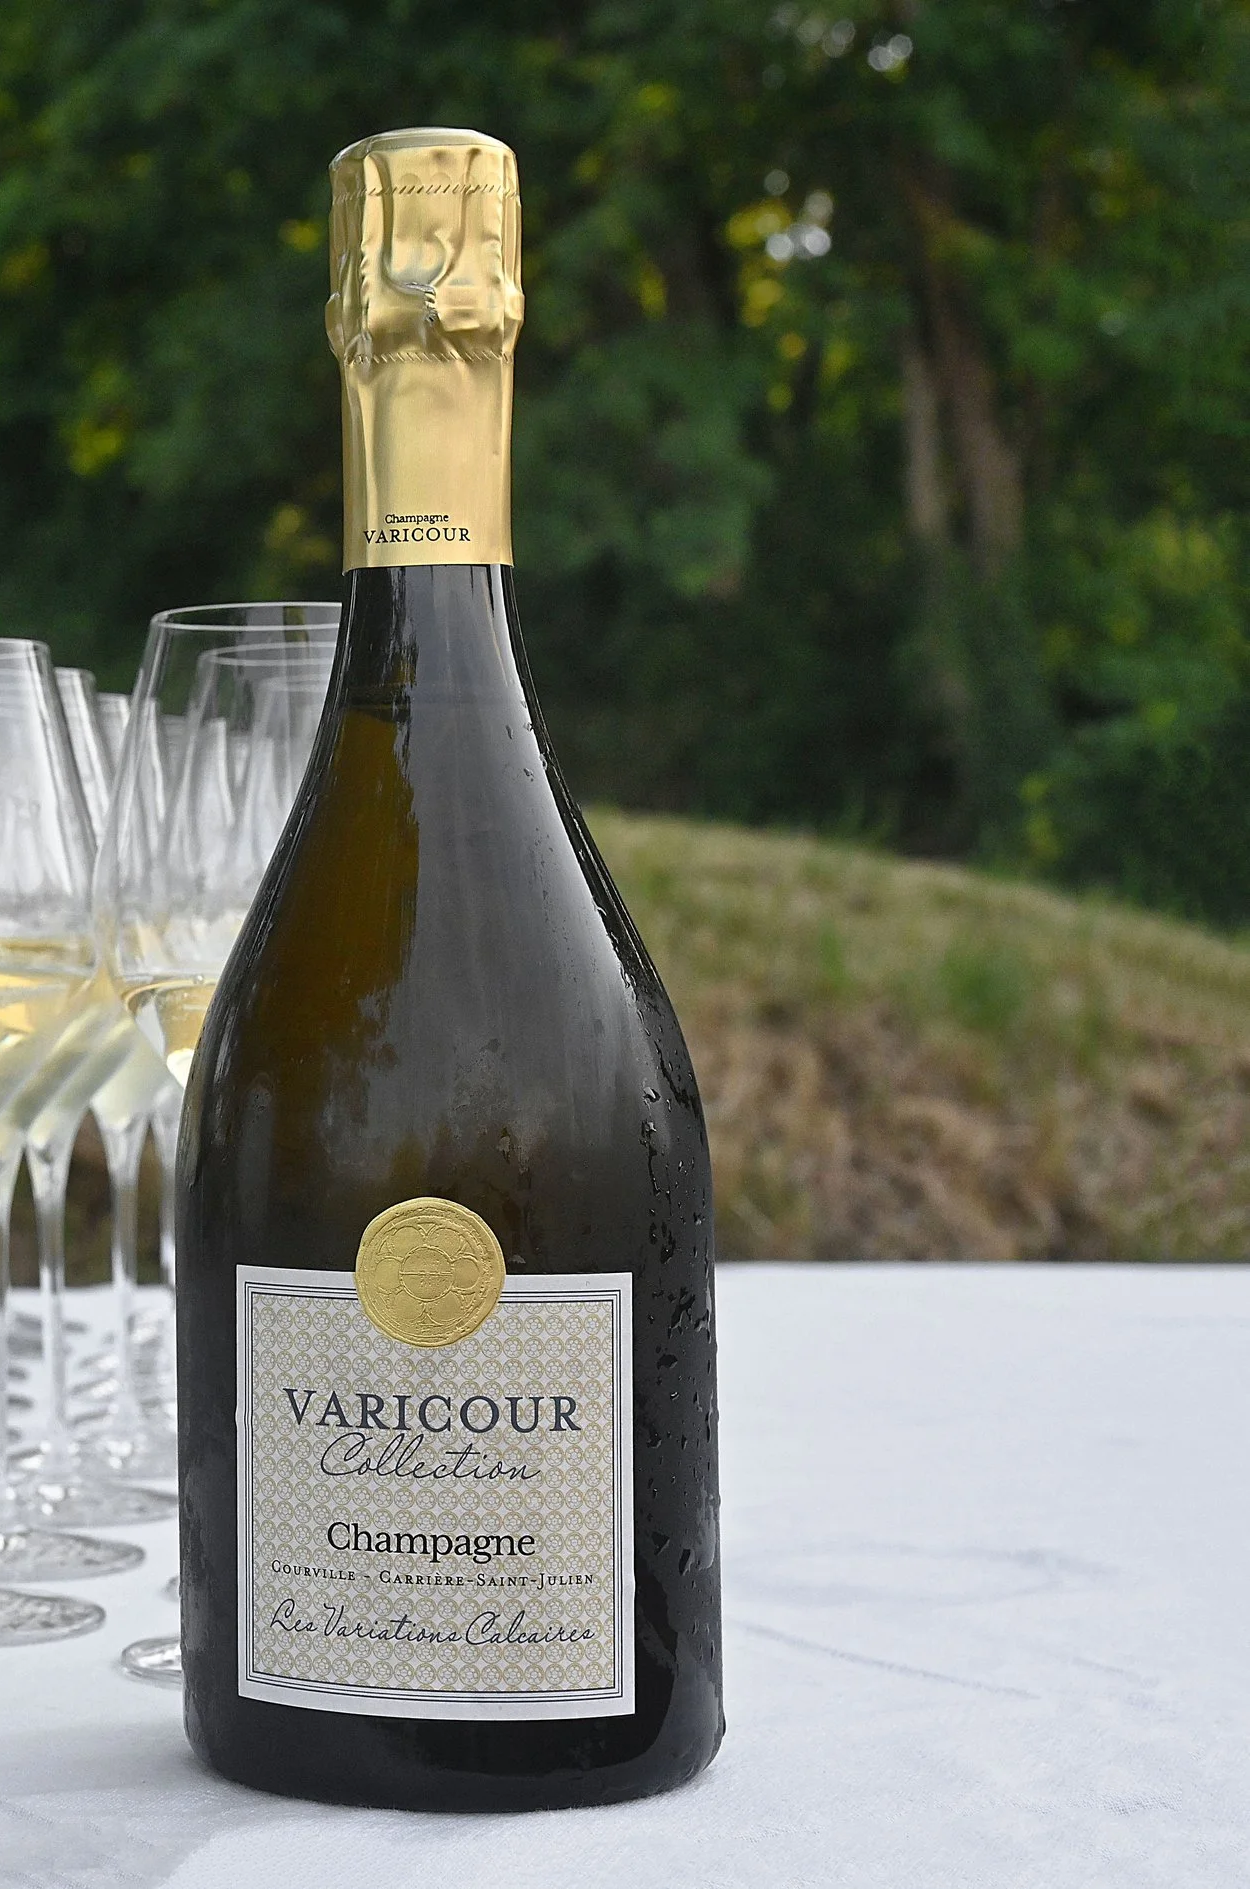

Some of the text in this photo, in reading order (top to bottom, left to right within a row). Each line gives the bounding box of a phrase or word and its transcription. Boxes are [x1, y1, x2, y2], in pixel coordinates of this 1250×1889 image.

[363, 527, 471, 544] VARICOUR
[384, 514, 449, 525] Champagne
[282, 1387, 582, 1434] VARICOUR
[320, 1432, 541, 1480] Collection
[327, 1521, 536, 1565] Champagne
[271, 1559, 356, 1582] COURVILLE
[270, 1598, 595, 1646] Les Variations Calcaires
